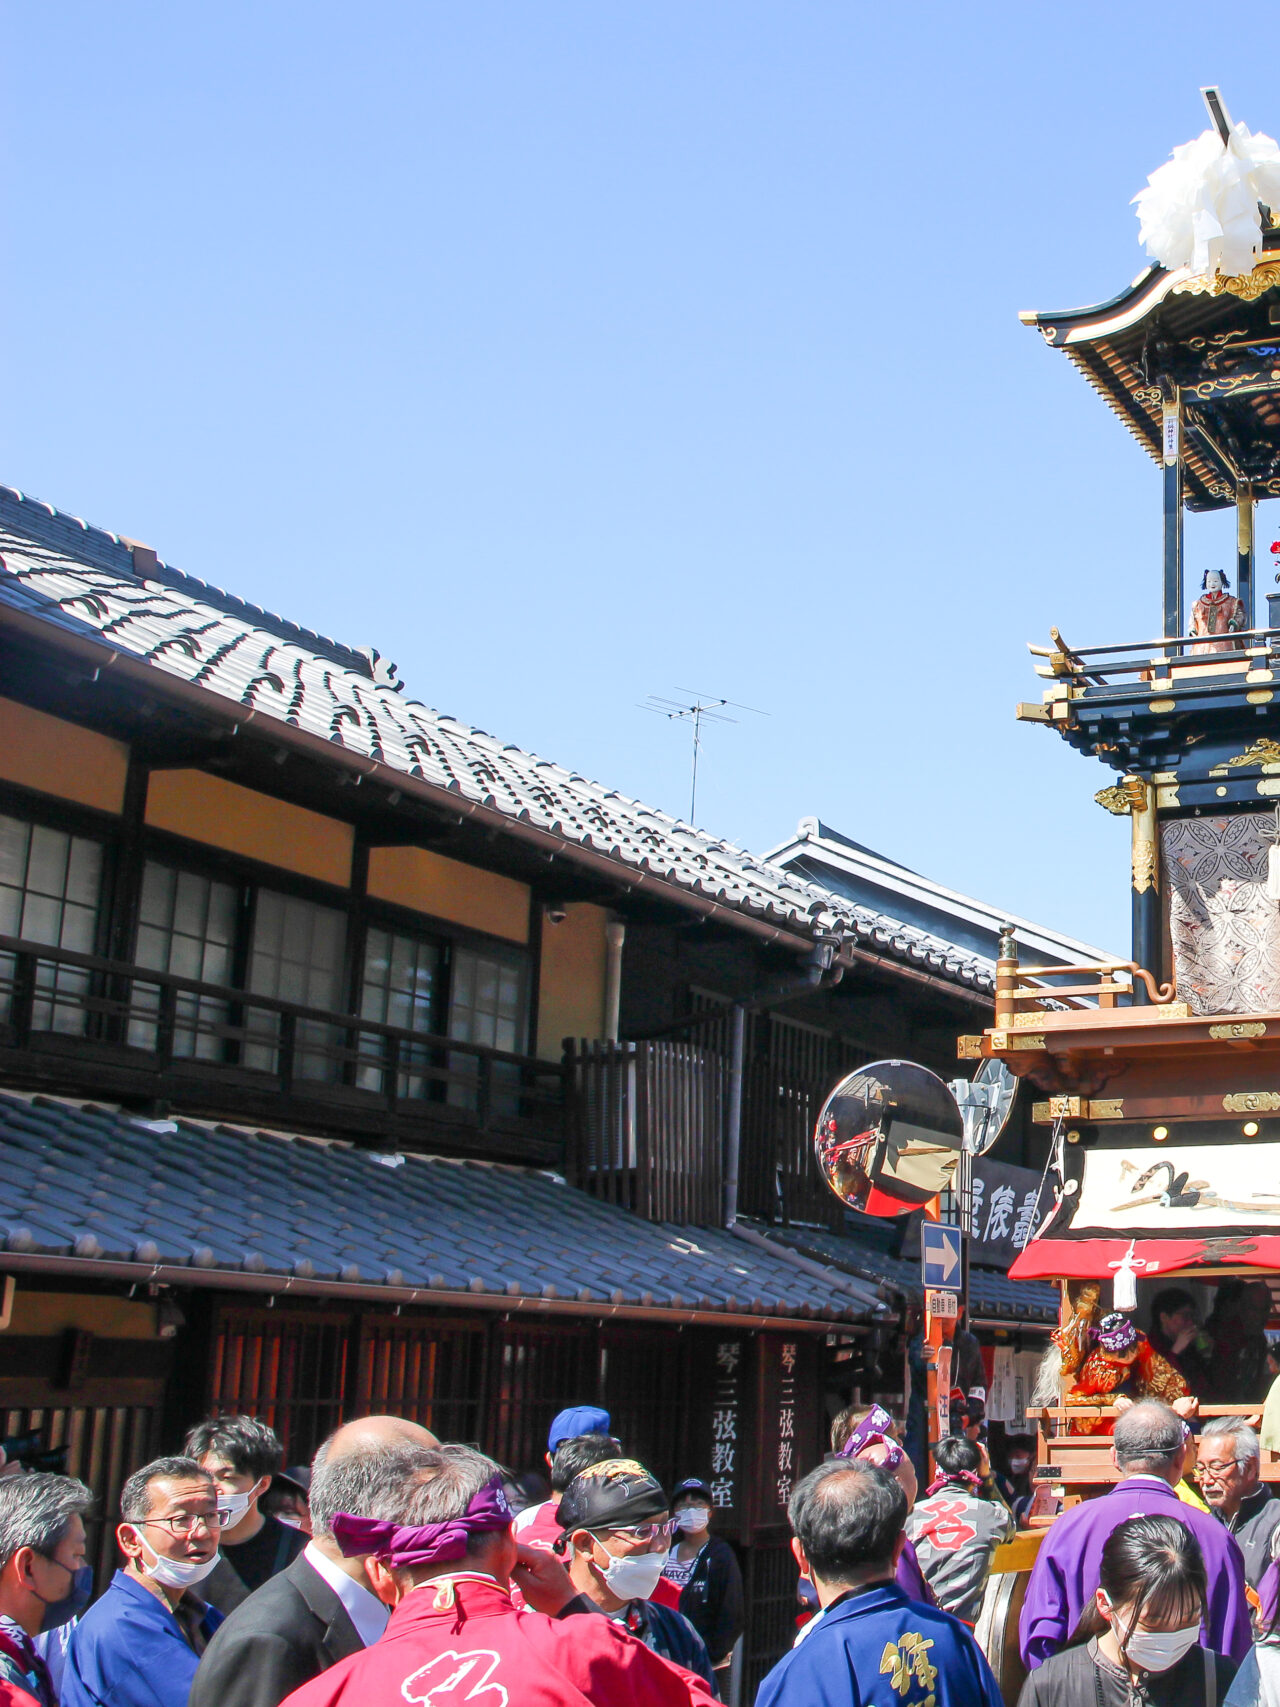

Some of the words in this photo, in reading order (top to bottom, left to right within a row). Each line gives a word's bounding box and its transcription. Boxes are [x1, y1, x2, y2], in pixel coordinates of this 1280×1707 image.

[710, 1343, 740, 1508] 琴三弦教室
[777, 1343, 797, 1506] 琴三弦教室
